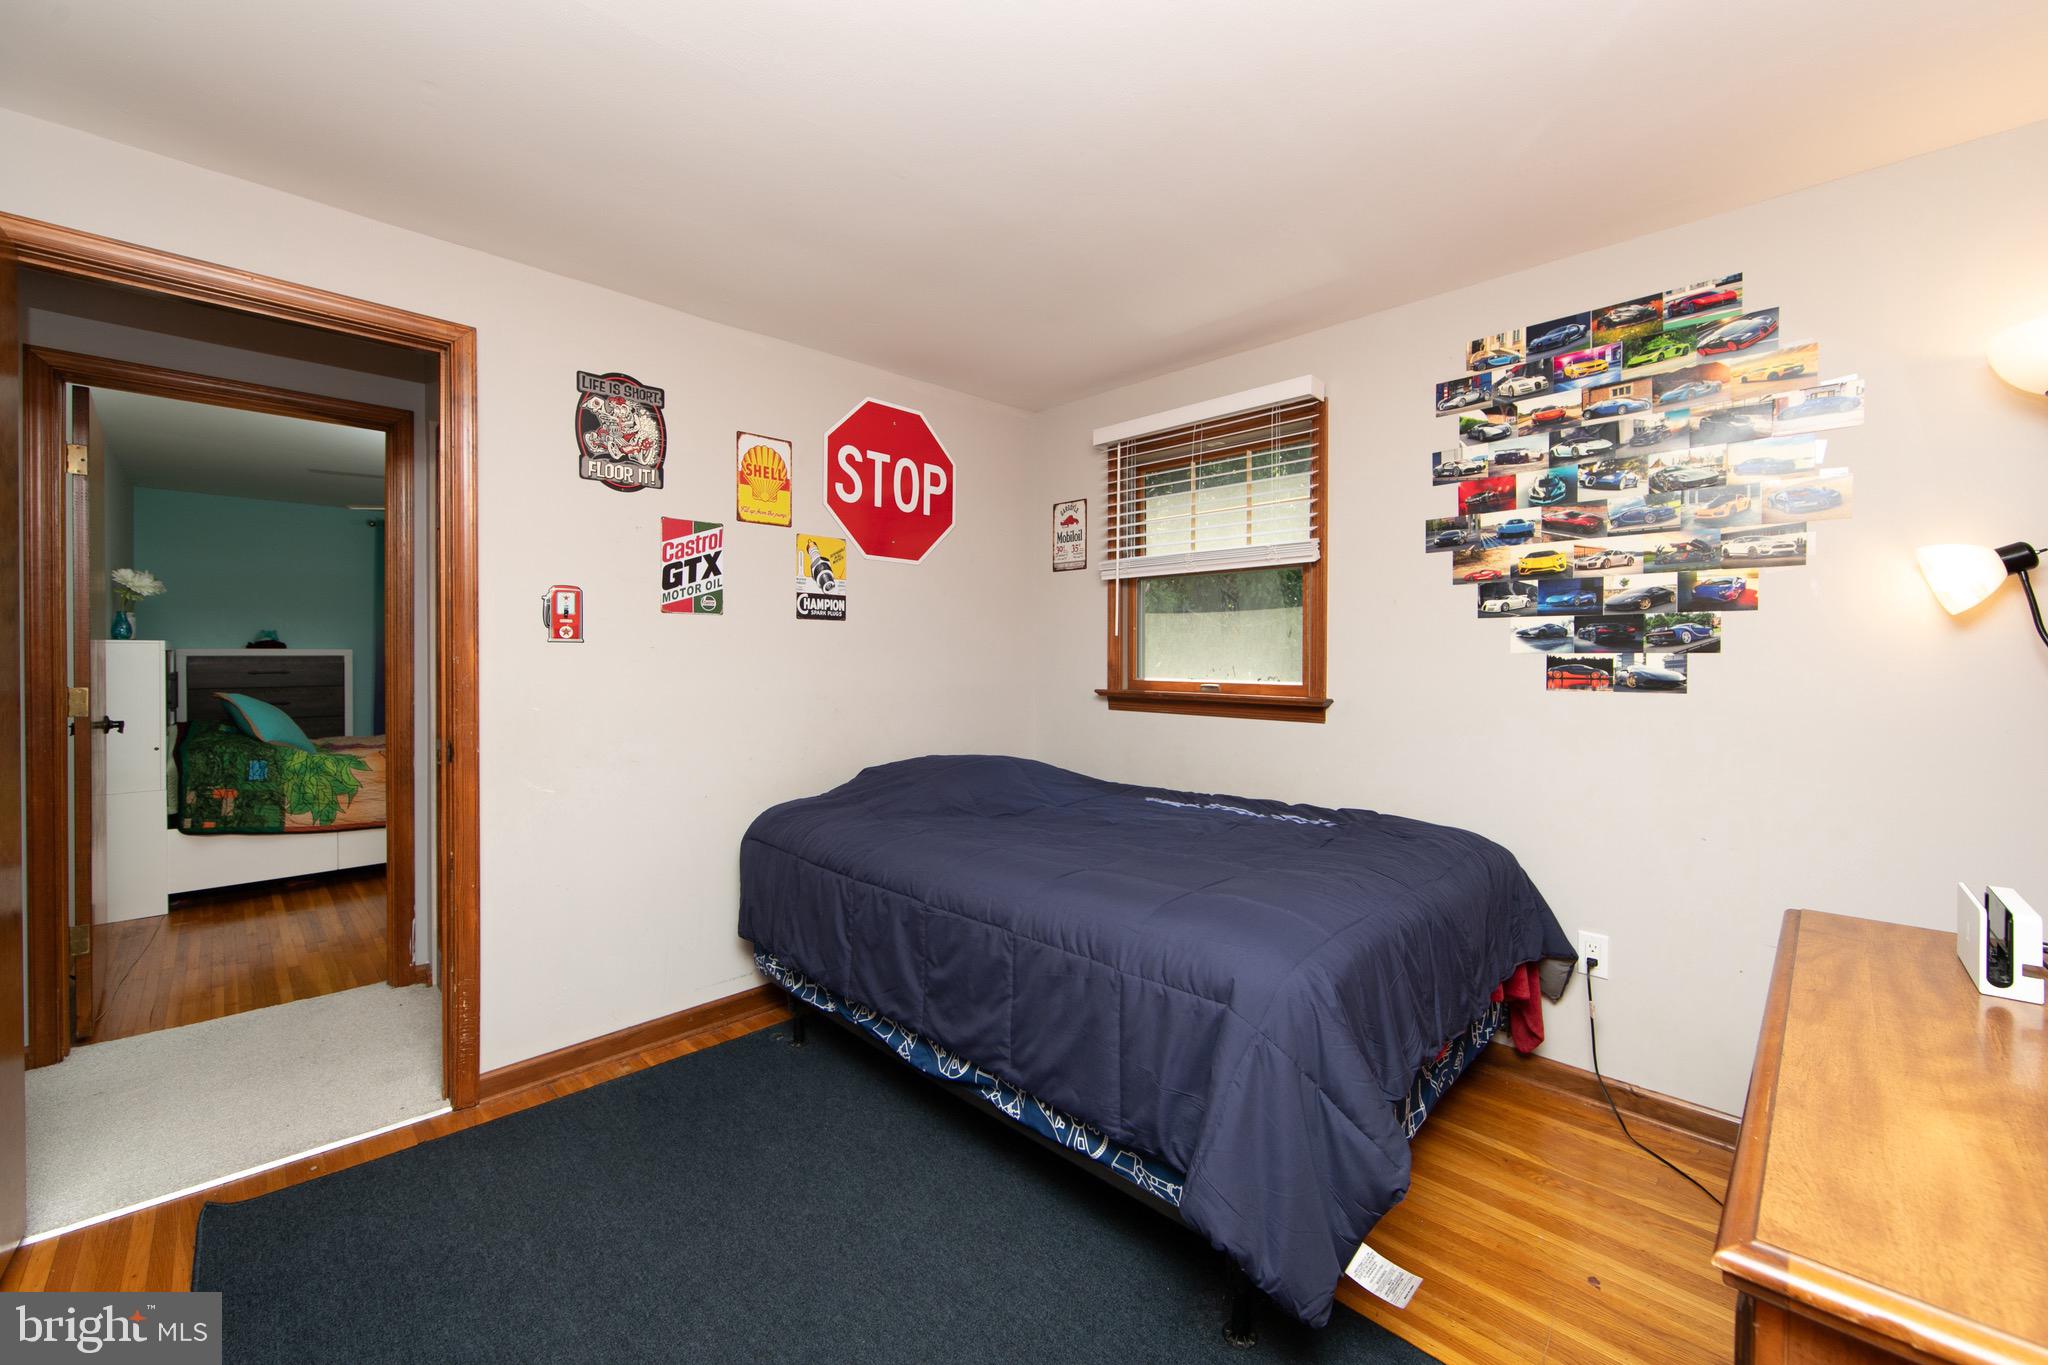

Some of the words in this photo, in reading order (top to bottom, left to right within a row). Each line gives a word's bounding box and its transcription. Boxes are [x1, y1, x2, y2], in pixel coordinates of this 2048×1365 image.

[582, 375, 606, 393] LIFE
[609, 382, 621, 396] IS
[588, 460, 633, 483] FLOOR
[638, 468, 656, 485] IT!
[746, 463, 785, 482] SHELL
[834, 444, 947, 516] STOP
[662, 528, 723, 563] Castrol
[1056, 529, 1083, 545] Mobiloil
[662, 550, 722, 591] GTX
[662, 584, 702, 603] MOTOR
[705, 578, 723, 591] OIL
[797, 593, 845, 615] CHAMPION
